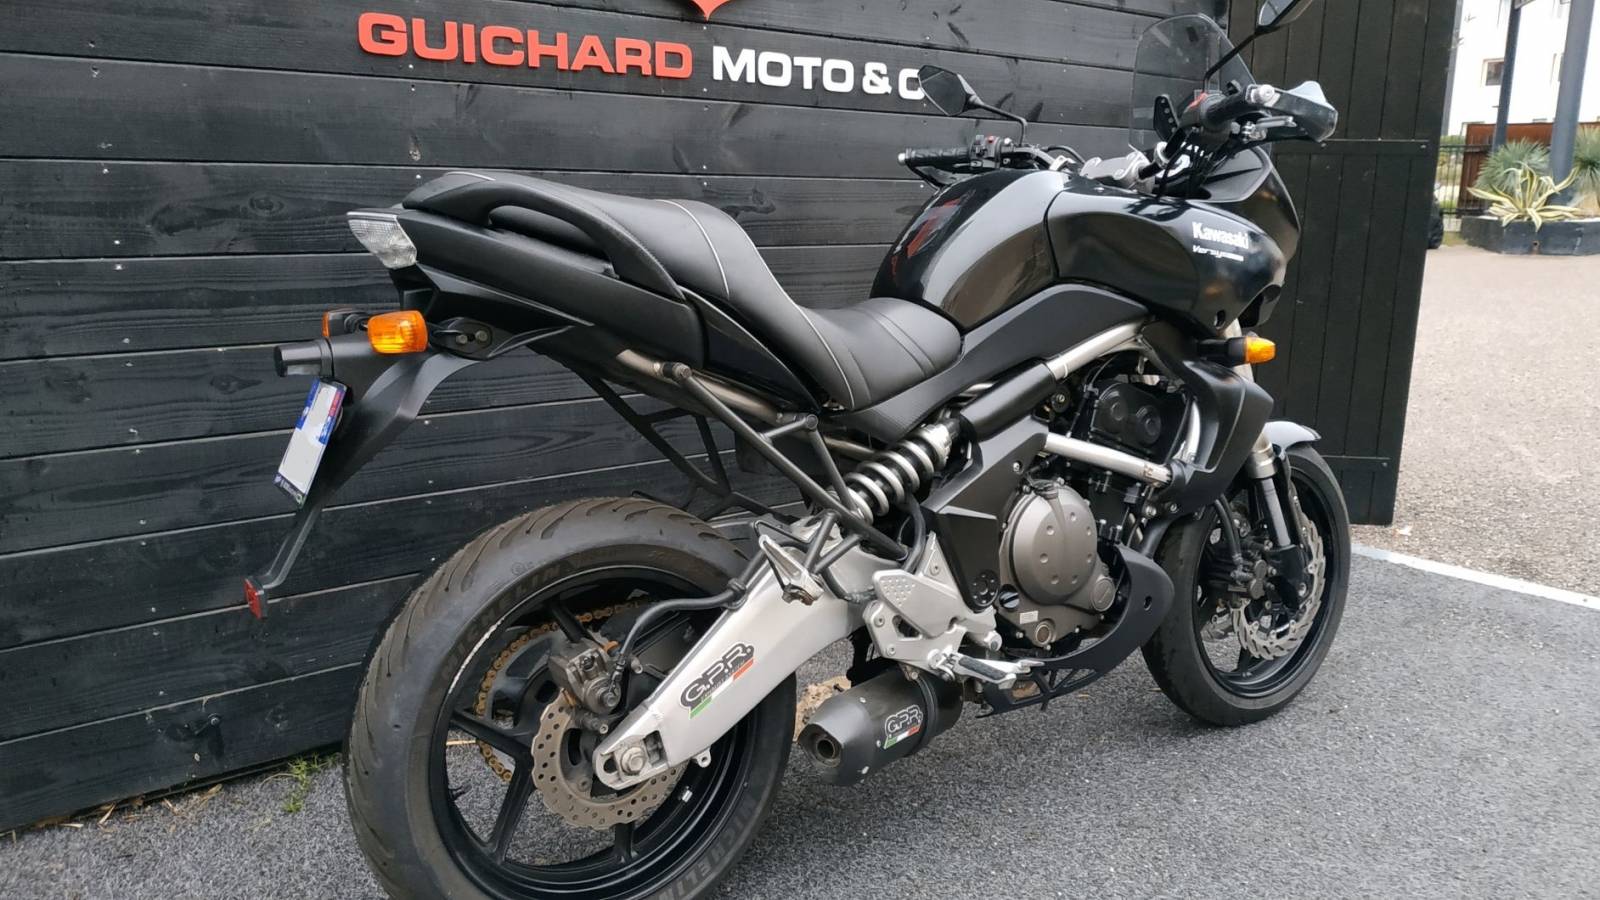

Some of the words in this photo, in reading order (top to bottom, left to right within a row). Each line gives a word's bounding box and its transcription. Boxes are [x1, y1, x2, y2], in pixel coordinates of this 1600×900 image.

[358, 12, 693, 78] GUICHARD
[711, 46, 856, 93] MOTO
[862, 62, 893, 94] &
[1192, 221, 1249, 249] Kawasaki
